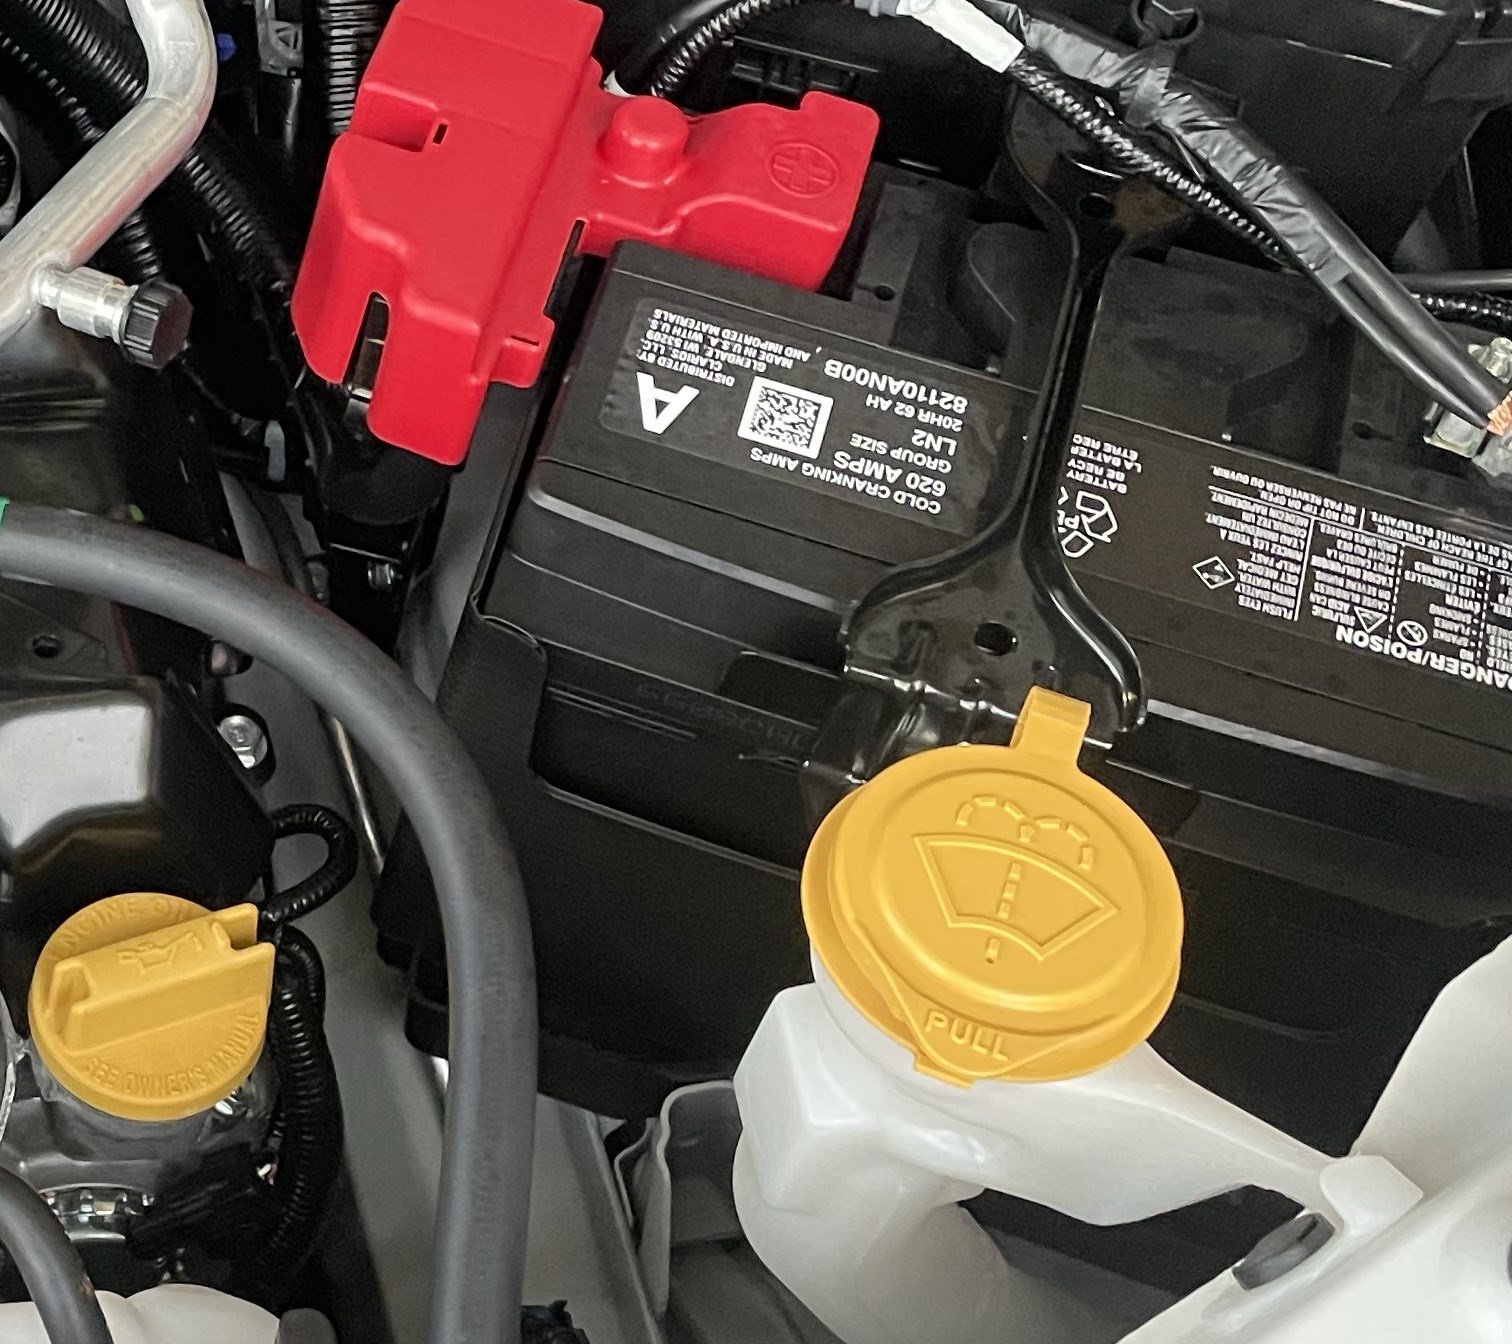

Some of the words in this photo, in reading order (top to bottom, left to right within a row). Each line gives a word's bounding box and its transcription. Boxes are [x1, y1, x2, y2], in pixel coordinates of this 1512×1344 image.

[653, 308, 720, 335] MATERIALS
[646, 329, 682, 347] 53209
[671, 325, 703, 342] WITH
[721, 328, 782, 353] IMPORTED
[683, 340, 699, 353] WI
[743, 346, 757, 357] IN
[784, 346, 810, 361] AND
[758, 350, 793, 368] MADE
[657, 356, 734, 386] DISTRIBUTED
[825, 360, 966, 412] 82110AN00B
[637, 372, 698, 432] A
[865, 393, 892, 410] AH
[894, 401, 914, 417] 62
[917, 408, 962, 431] 20HR
[849, 433, 887, 454] SIZE
[911, 429, 956, 455] LN2
[748, 445, 799, 472] AMPS
[834, 451, 901, 482] AMPS
[890, 447, 951, 472] GROUP
[1067, 458, 1103, 475] RECY
[1070, 445, 1121, 466] BATTER
[801, 462, 890, 498] CRANKING
[905, 472, 945, 496] 620
[893, 490, 940, 513] COLD
[924, 1008, 1010, 1062] PULL
[88, 1053, 119, 1088] SEE
[201, 1011, 259, 1080] MANUAL
